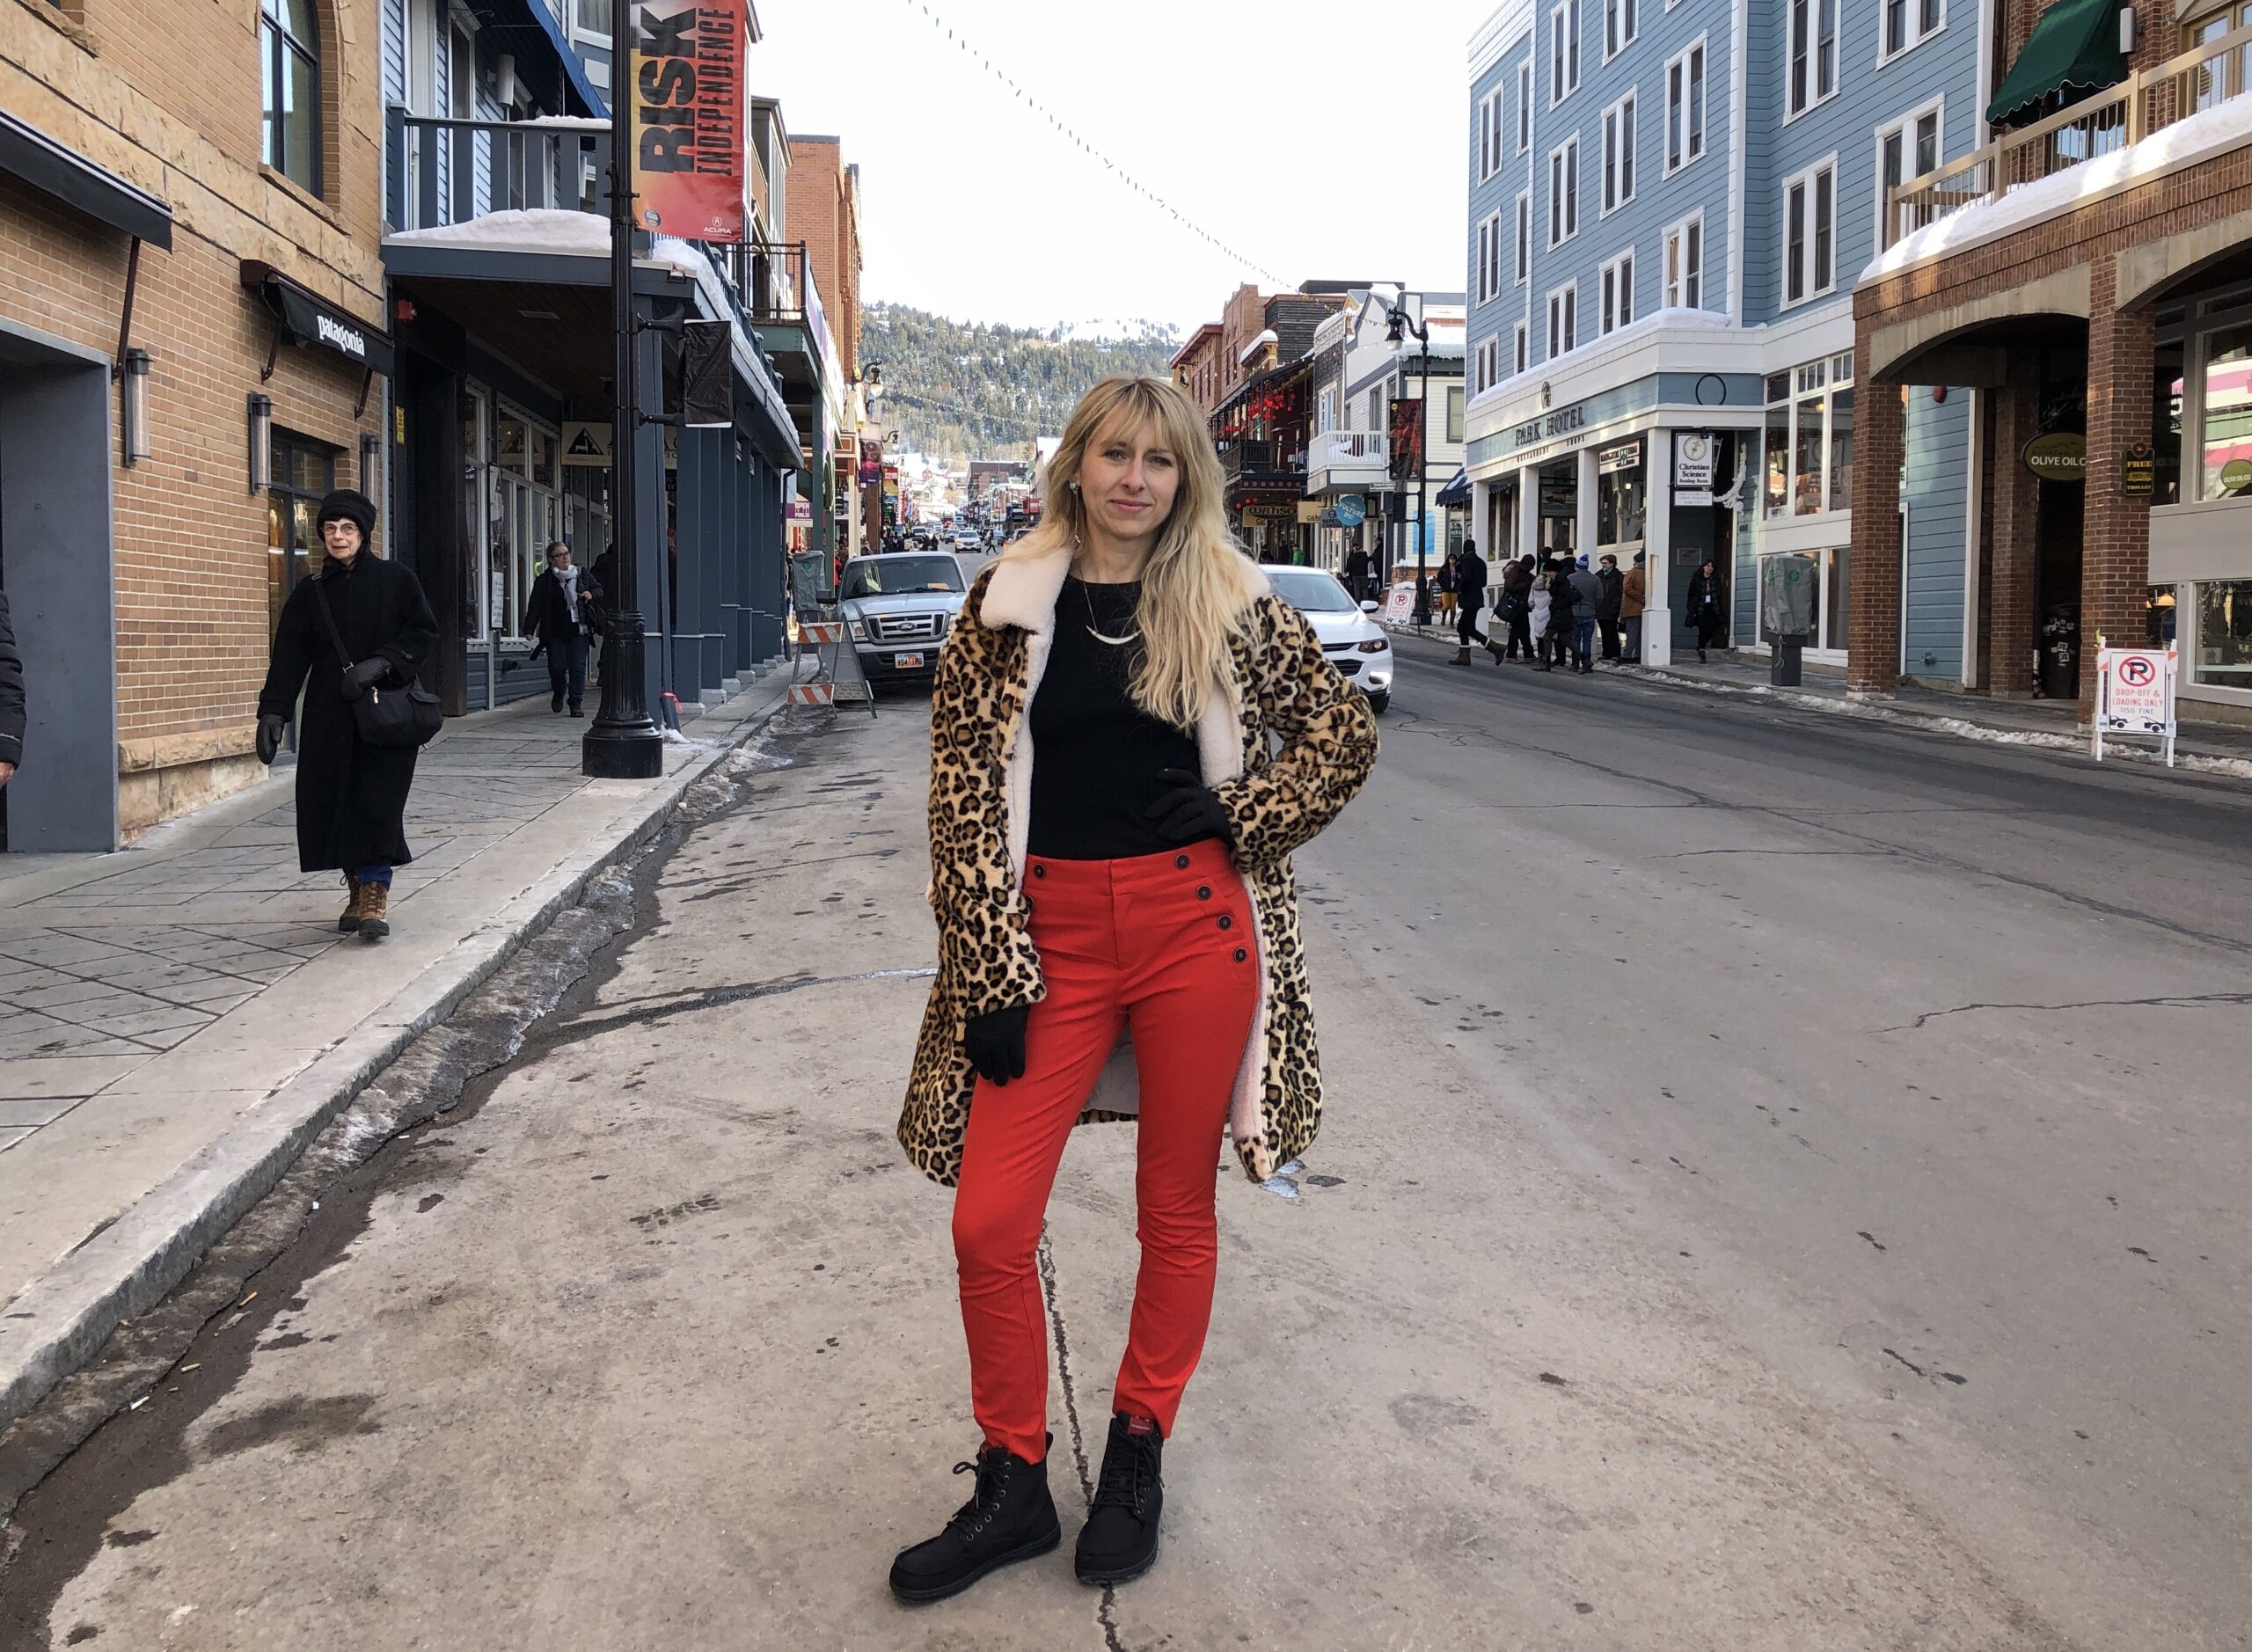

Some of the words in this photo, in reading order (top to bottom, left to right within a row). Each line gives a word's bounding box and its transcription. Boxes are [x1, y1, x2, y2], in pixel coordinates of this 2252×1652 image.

[639, 5, 697, 174] RISK
[697, 7, 735, 177] INDEPENDENCE
[317, 315, 365, 357] patagonia
[1515, 421, 1541, 447] PARK
[1546, 406, 1584, 436] HOTEL
[2031, 456, 2060, 465] OLIVE
[2061, 457, 2079, 466] OIL
[1339, 501, 1365, 519] VULTURE
[2117, 688, 2151, 697] DROP-OFF
